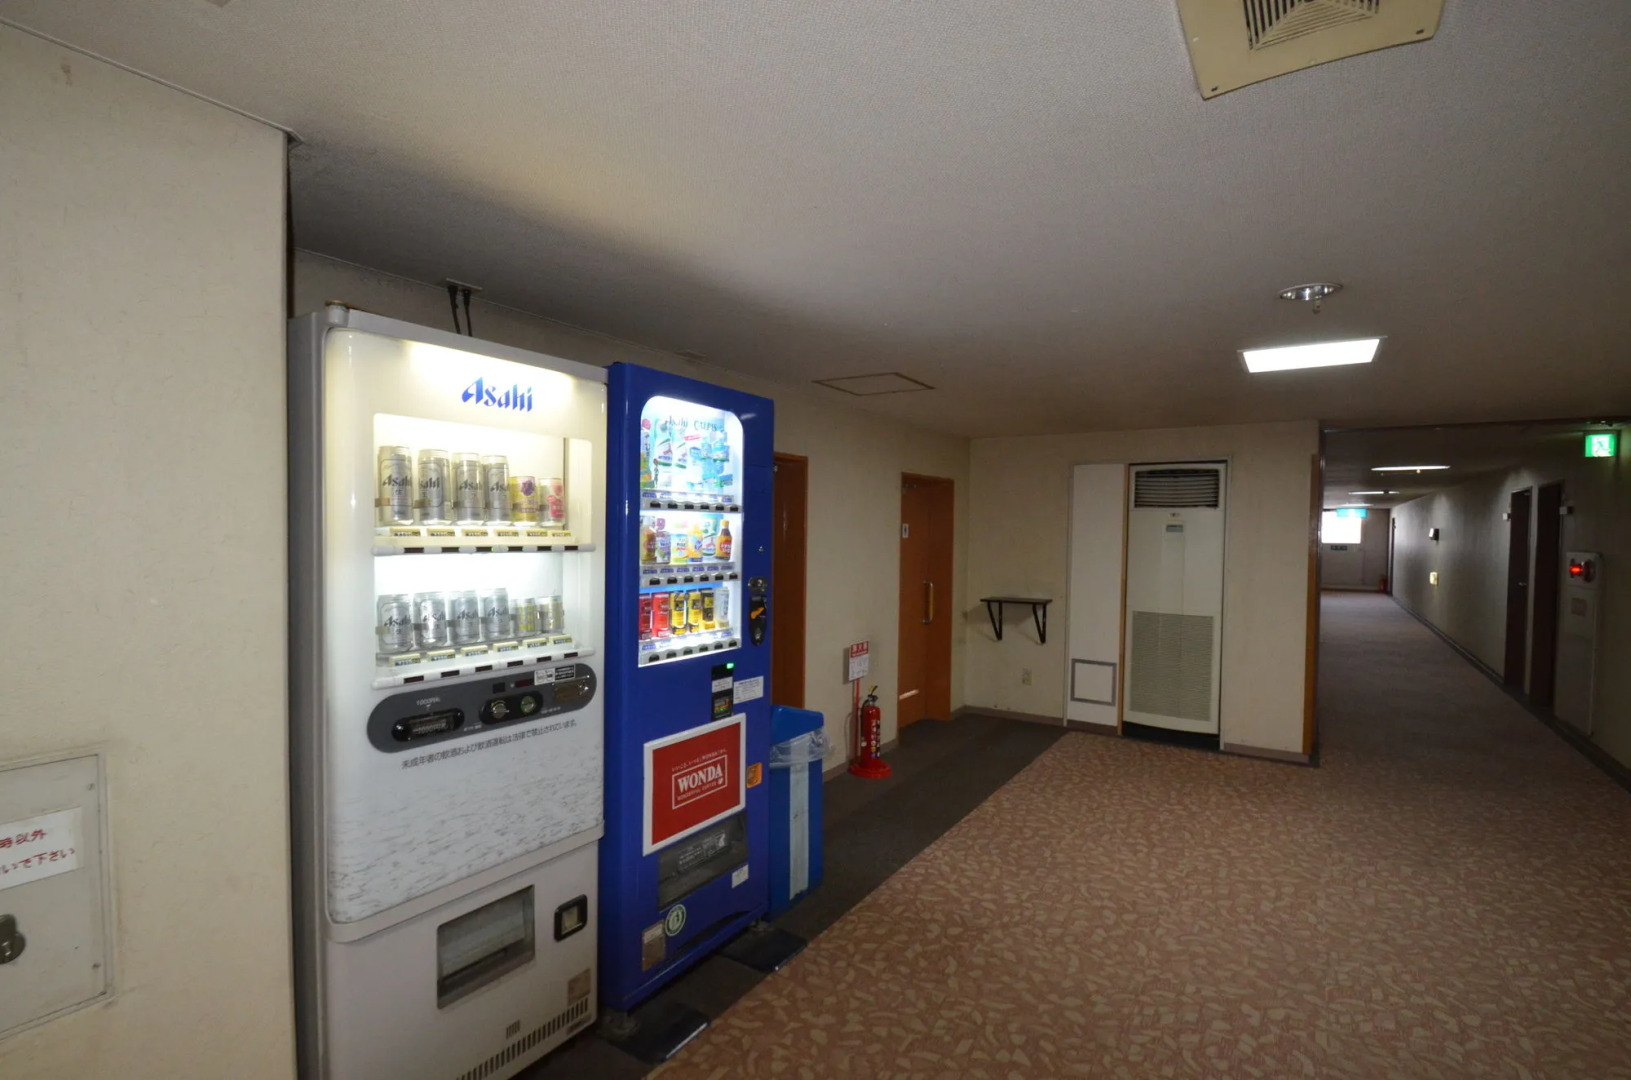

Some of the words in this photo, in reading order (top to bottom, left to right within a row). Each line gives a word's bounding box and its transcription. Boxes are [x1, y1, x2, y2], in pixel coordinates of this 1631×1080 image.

[461, 376, 533, 412] Asahi
[677, 764, 723, 793] WONDA
[0, 848, 75, 874] いで下さい
